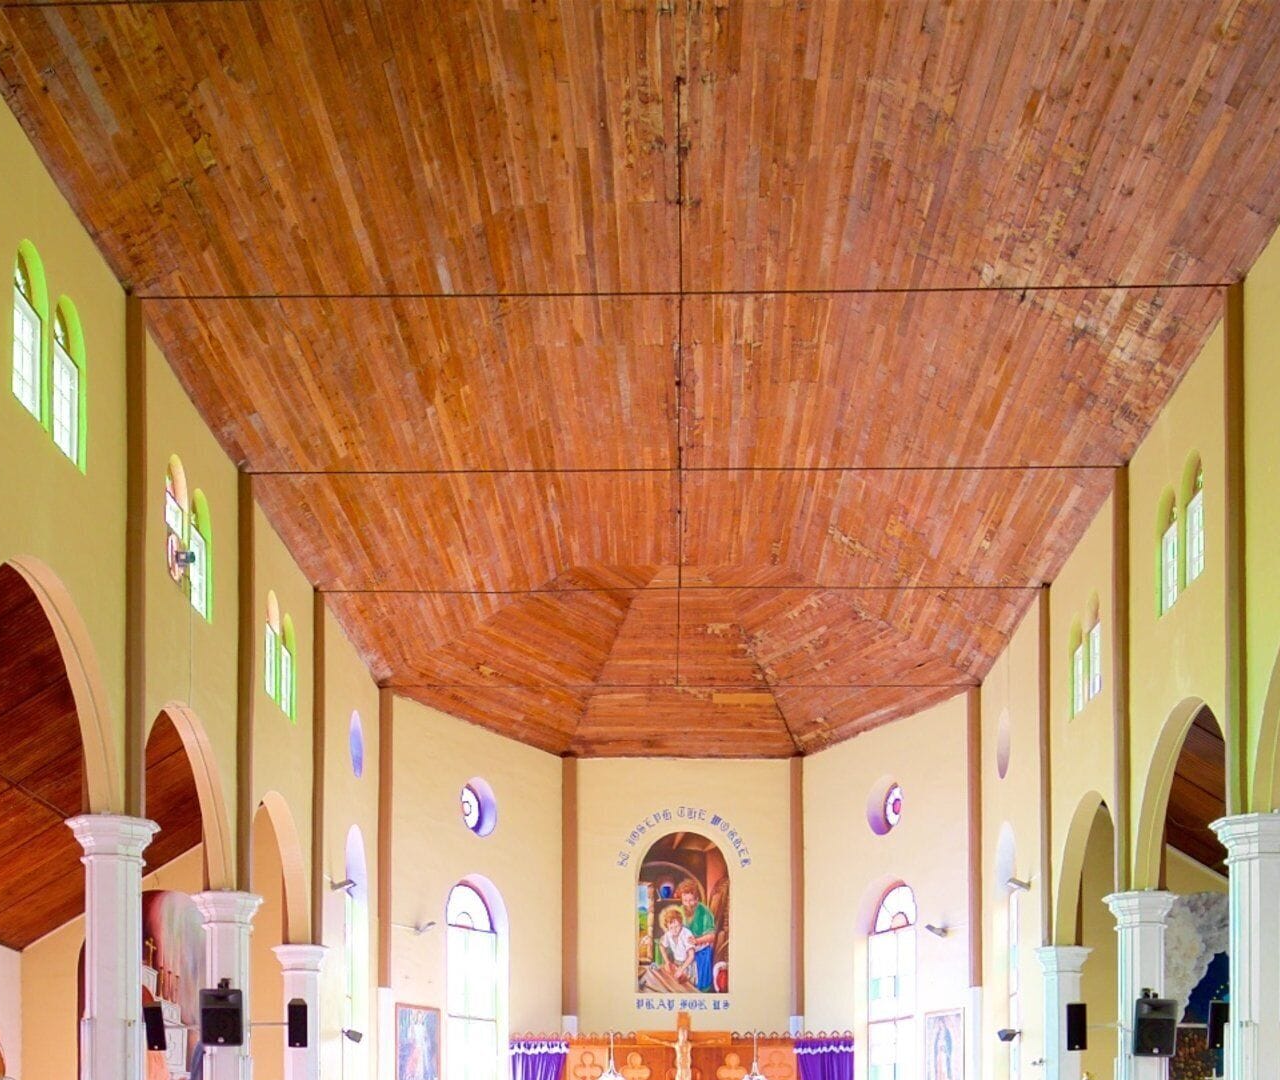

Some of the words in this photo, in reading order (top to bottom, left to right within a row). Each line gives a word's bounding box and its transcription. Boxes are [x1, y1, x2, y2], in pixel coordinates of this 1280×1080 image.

[626, 809, 672, 846] JOSEPH
[677, 806, 707, 820] THE
[710, 814, 751, 867] WORKER
[636, 999, 675, 1011] PRAY
[680, 999, 707, 1010] FOR
[713, 1000, 729, 1010] US
